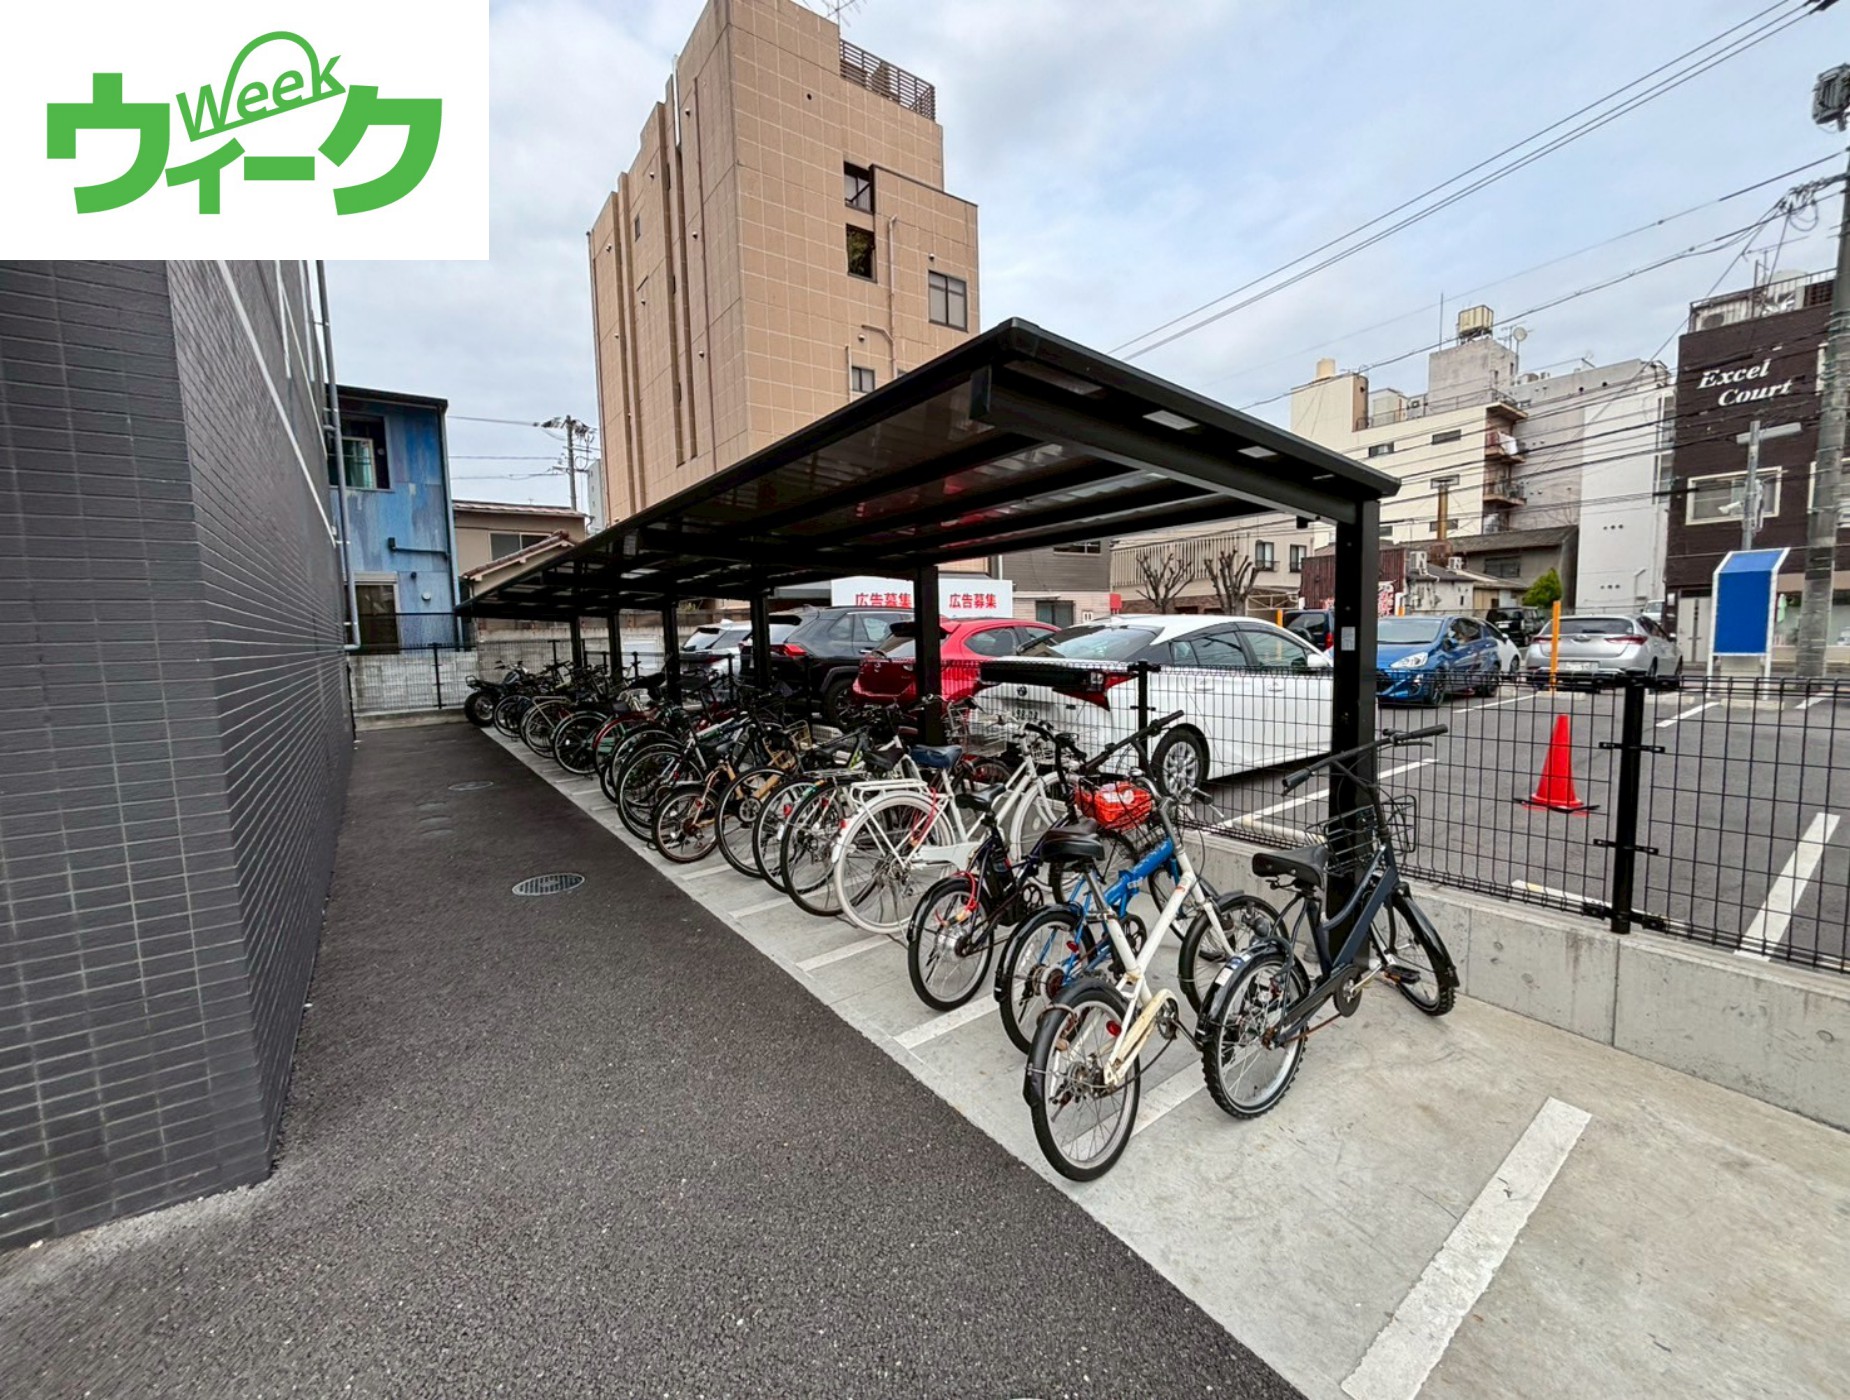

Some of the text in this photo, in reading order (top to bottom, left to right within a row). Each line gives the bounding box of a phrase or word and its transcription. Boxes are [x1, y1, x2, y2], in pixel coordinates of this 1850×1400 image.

[1697, 358, 1771, 389] Excel
[1718, 379, 1793, 406] Court
[855, 592, 912, 608] 広告募集
[949, 593, 997, 609] 広告募集
